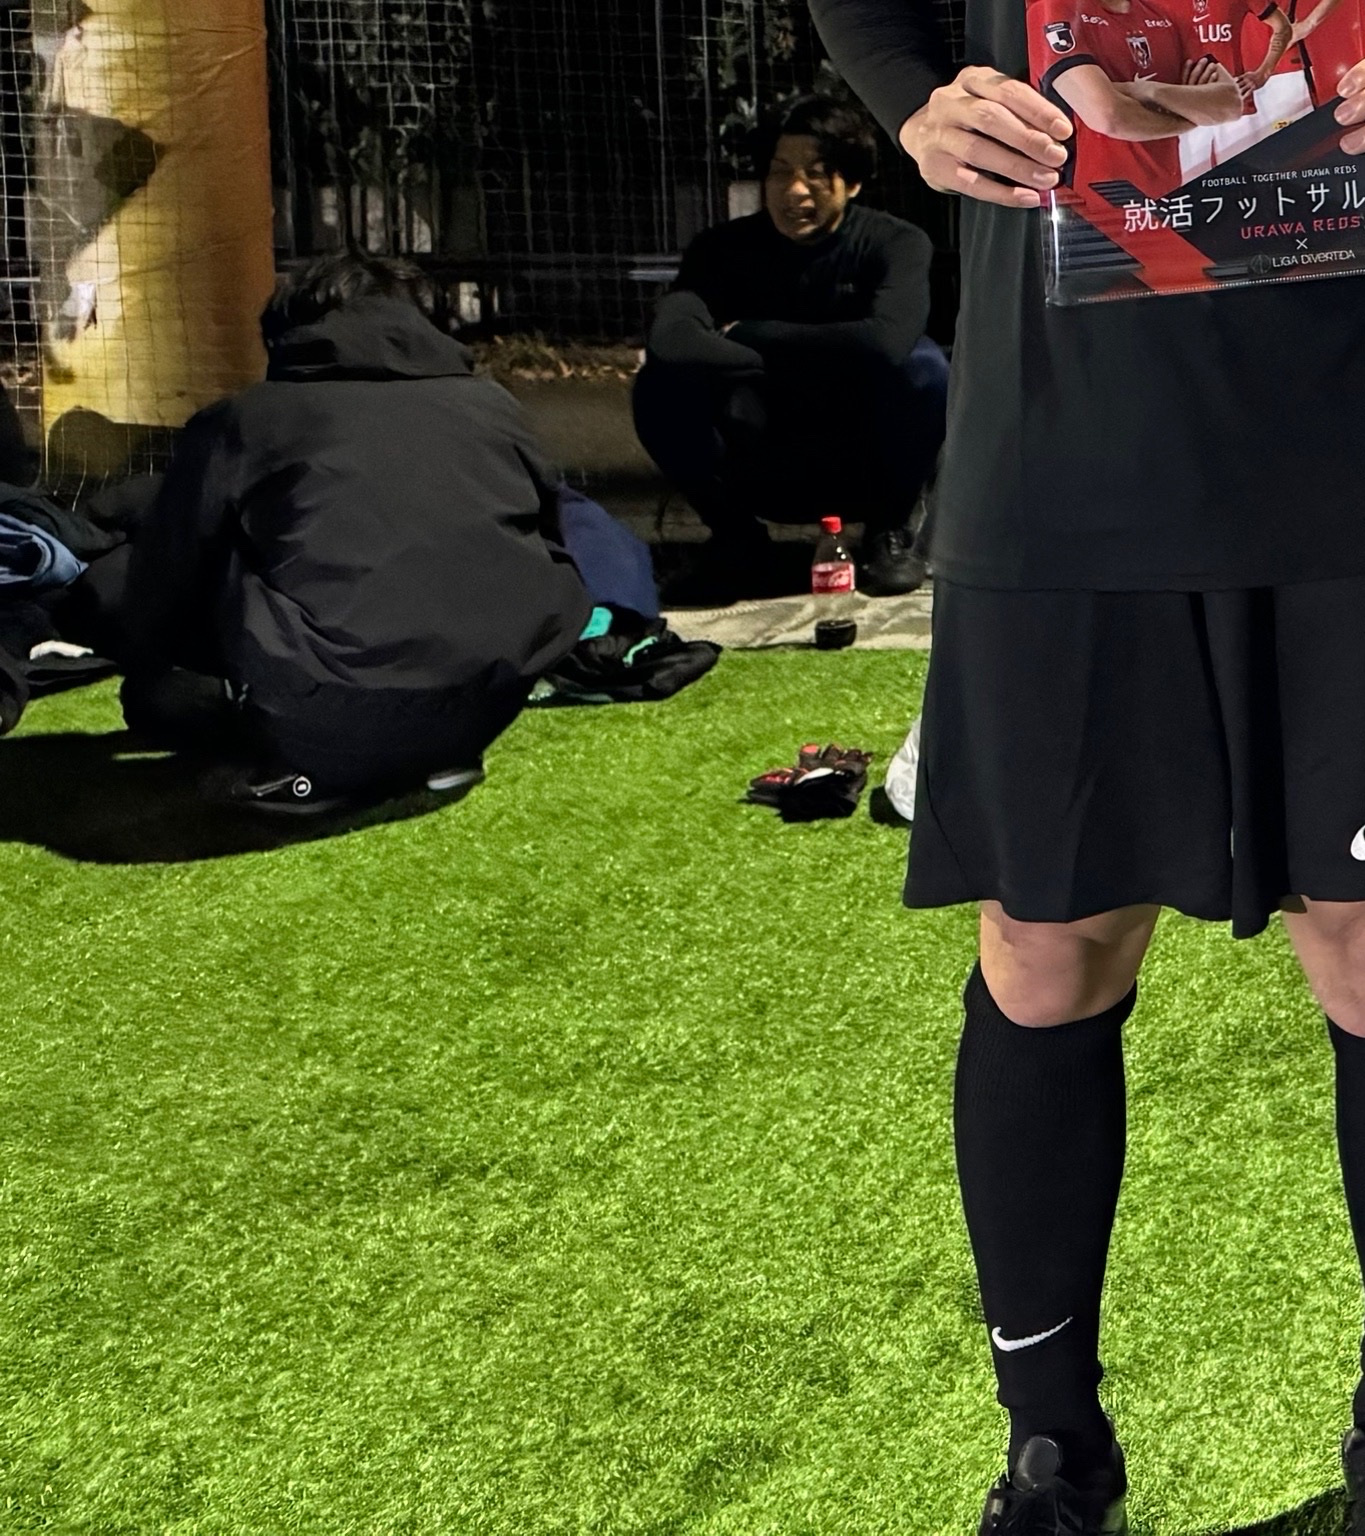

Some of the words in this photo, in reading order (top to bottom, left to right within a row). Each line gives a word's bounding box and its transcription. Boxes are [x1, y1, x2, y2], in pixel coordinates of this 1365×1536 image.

[1195, 23, 1233, 43] LUS
[1201, 176, 1247, 188] FOOTBALL
[1252, 170, 1298, 183] TOGETHER
[1301, 166, 1331, 179] URAWA
[1333, 164, 1358, 175] REDS
[1240, 222, 1306, 239] URAWA
[1313, 215, 1361, 232] REDS
